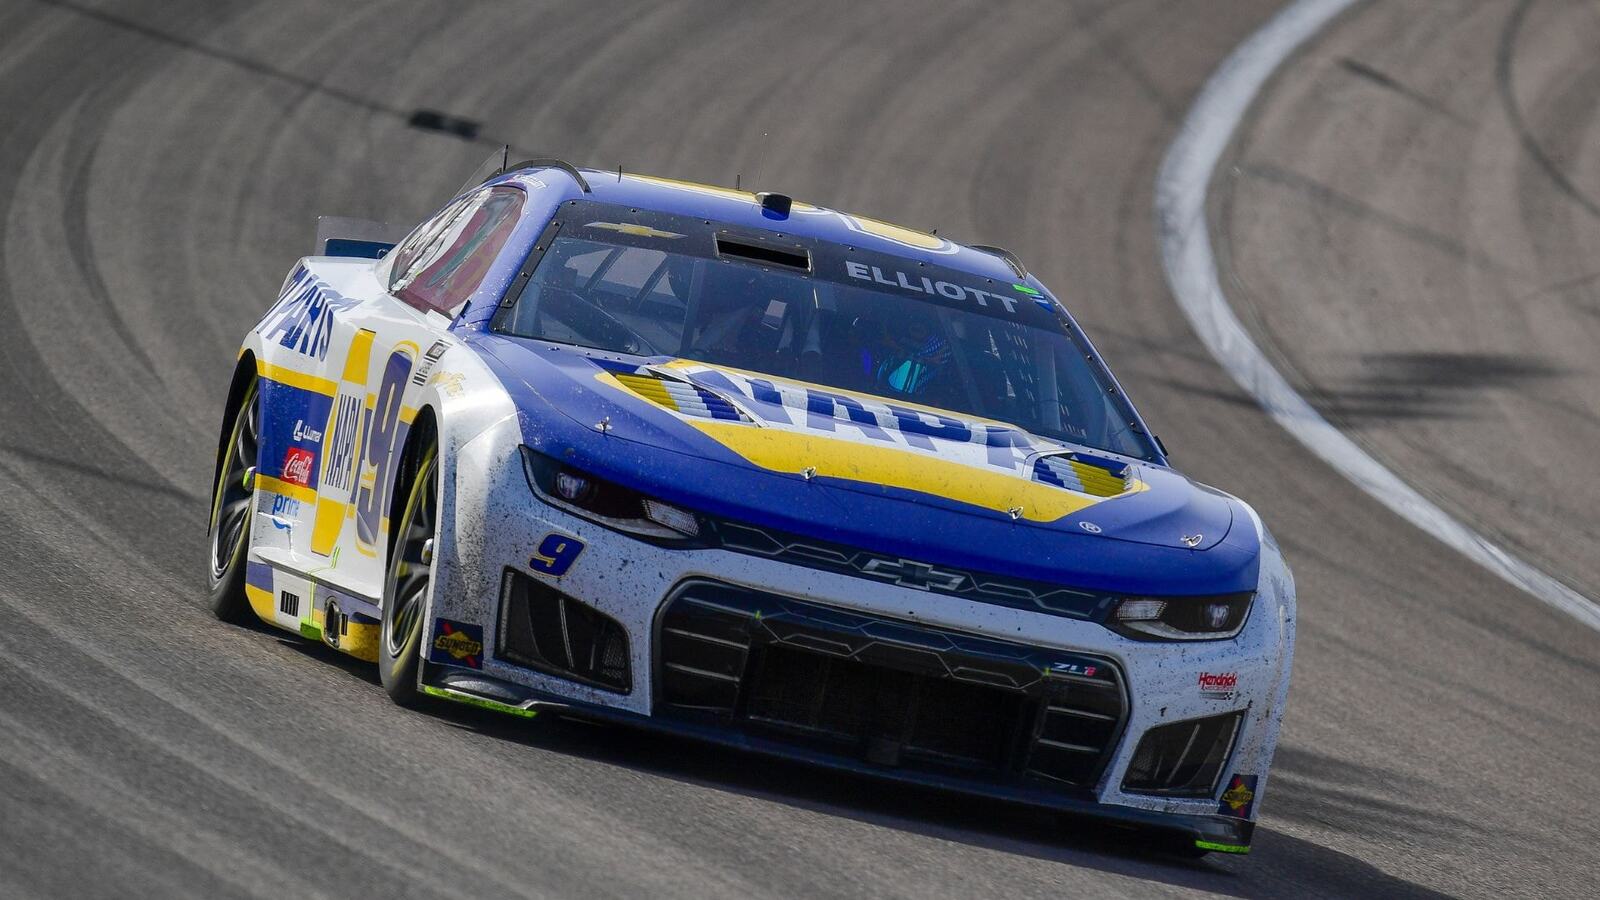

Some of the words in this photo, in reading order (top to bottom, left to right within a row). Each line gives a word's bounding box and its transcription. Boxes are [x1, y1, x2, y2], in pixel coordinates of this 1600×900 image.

[846, 260, 1017, 313] ELLIOTT
[325, 393, 362, 491] NAPA
[355, 343, 417, 554] 9
[686, 368, 1046, 471] NAPA
[528, 533, 586, 577] 9
